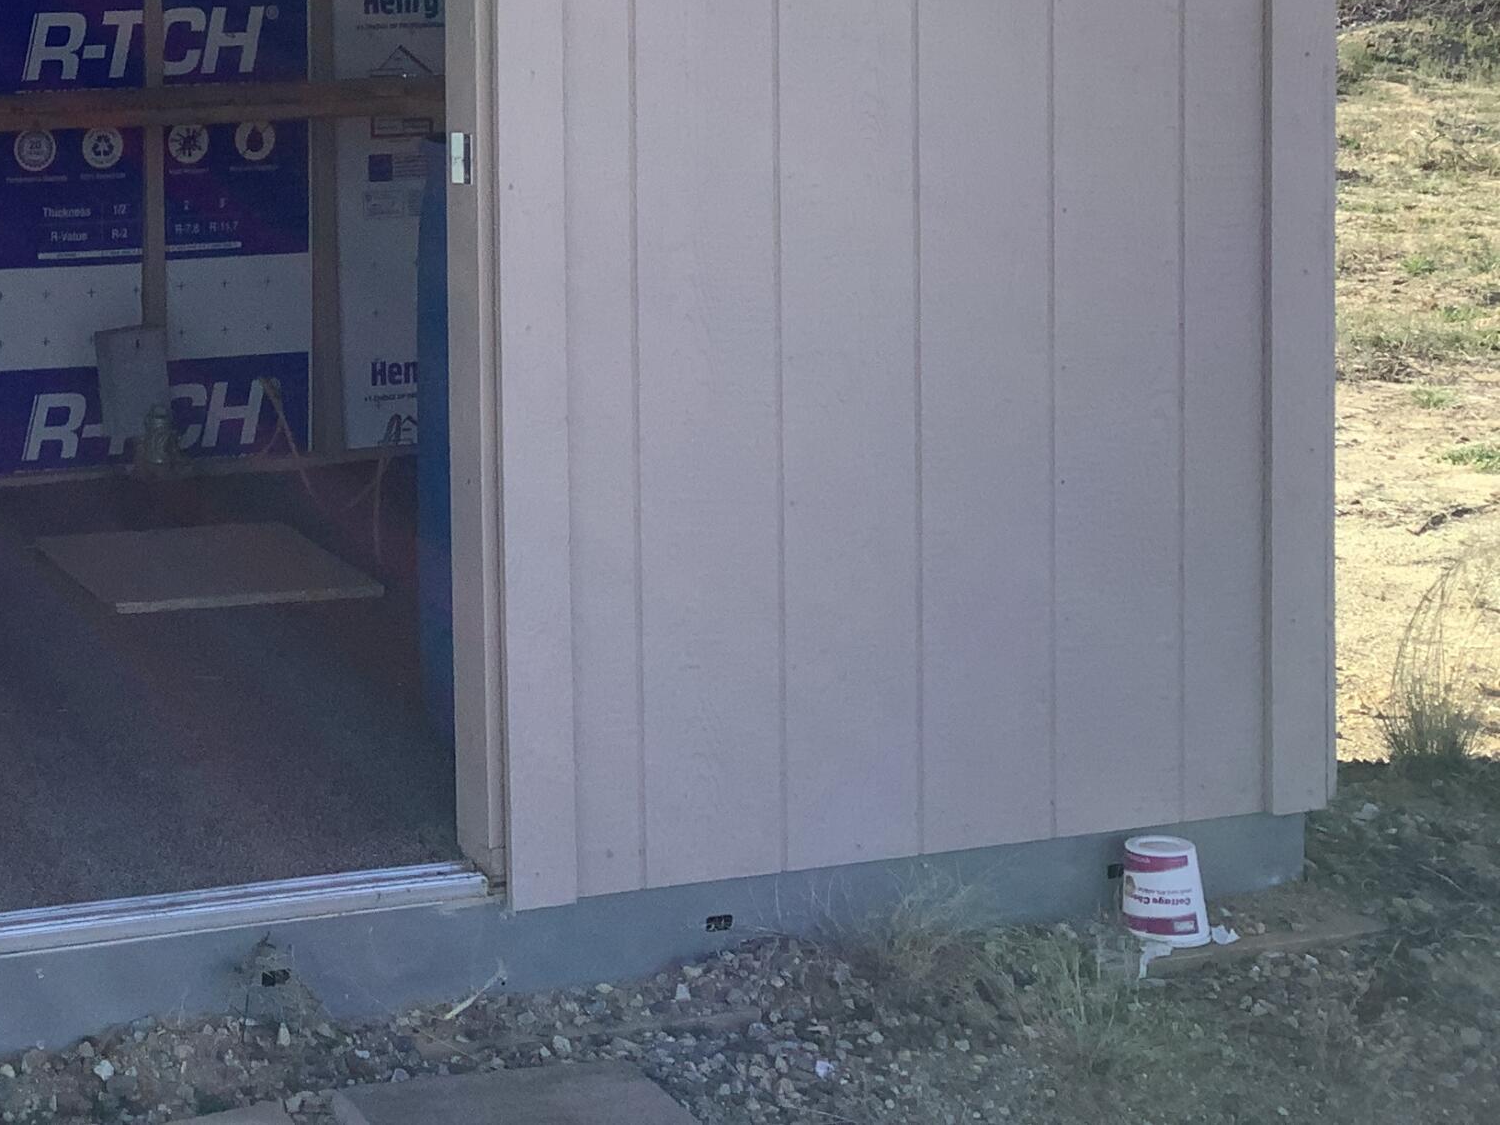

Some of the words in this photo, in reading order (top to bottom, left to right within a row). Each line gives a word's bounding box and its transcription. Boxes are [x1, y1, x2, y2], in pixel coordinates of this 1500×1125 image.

[29, 140, 42, 150] 20
[42, 205, 92, 219] Thickness
[50, 230, 88, 244] R-Value
[111, 227, 128, 240] R-2
[371, 360, 419, 387] Hen
[1151, 896, 1191, 906] Cottage
